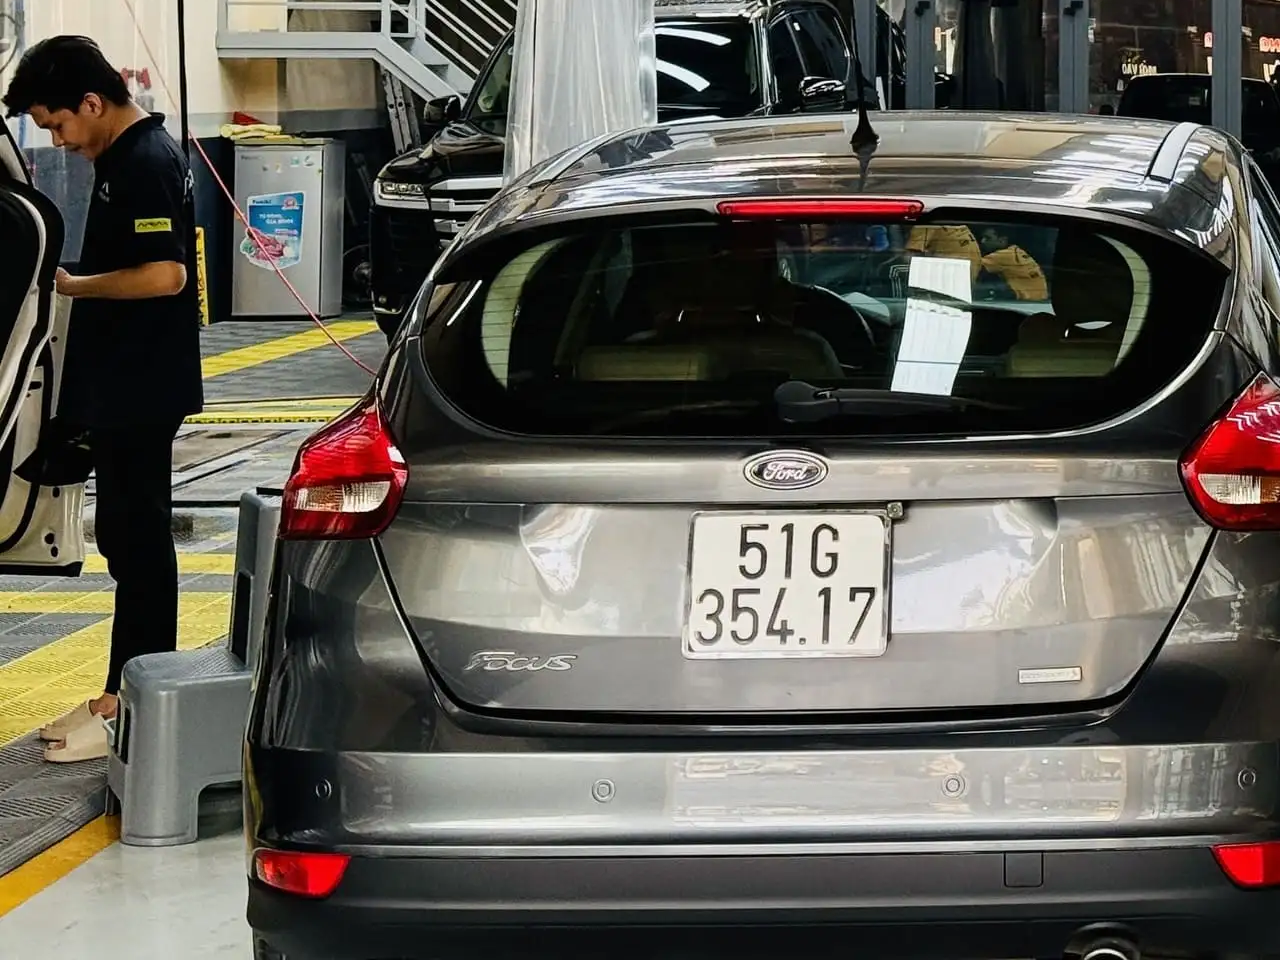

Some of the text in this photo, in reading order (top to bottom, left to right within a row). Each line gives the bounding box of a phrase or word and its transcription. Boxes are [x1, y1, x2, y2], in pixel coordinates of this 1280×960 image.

[763, 460, 809, 481] Ford
[738, 522, 839, 580] 51G
[694, 586, 877, 647] 354.17
